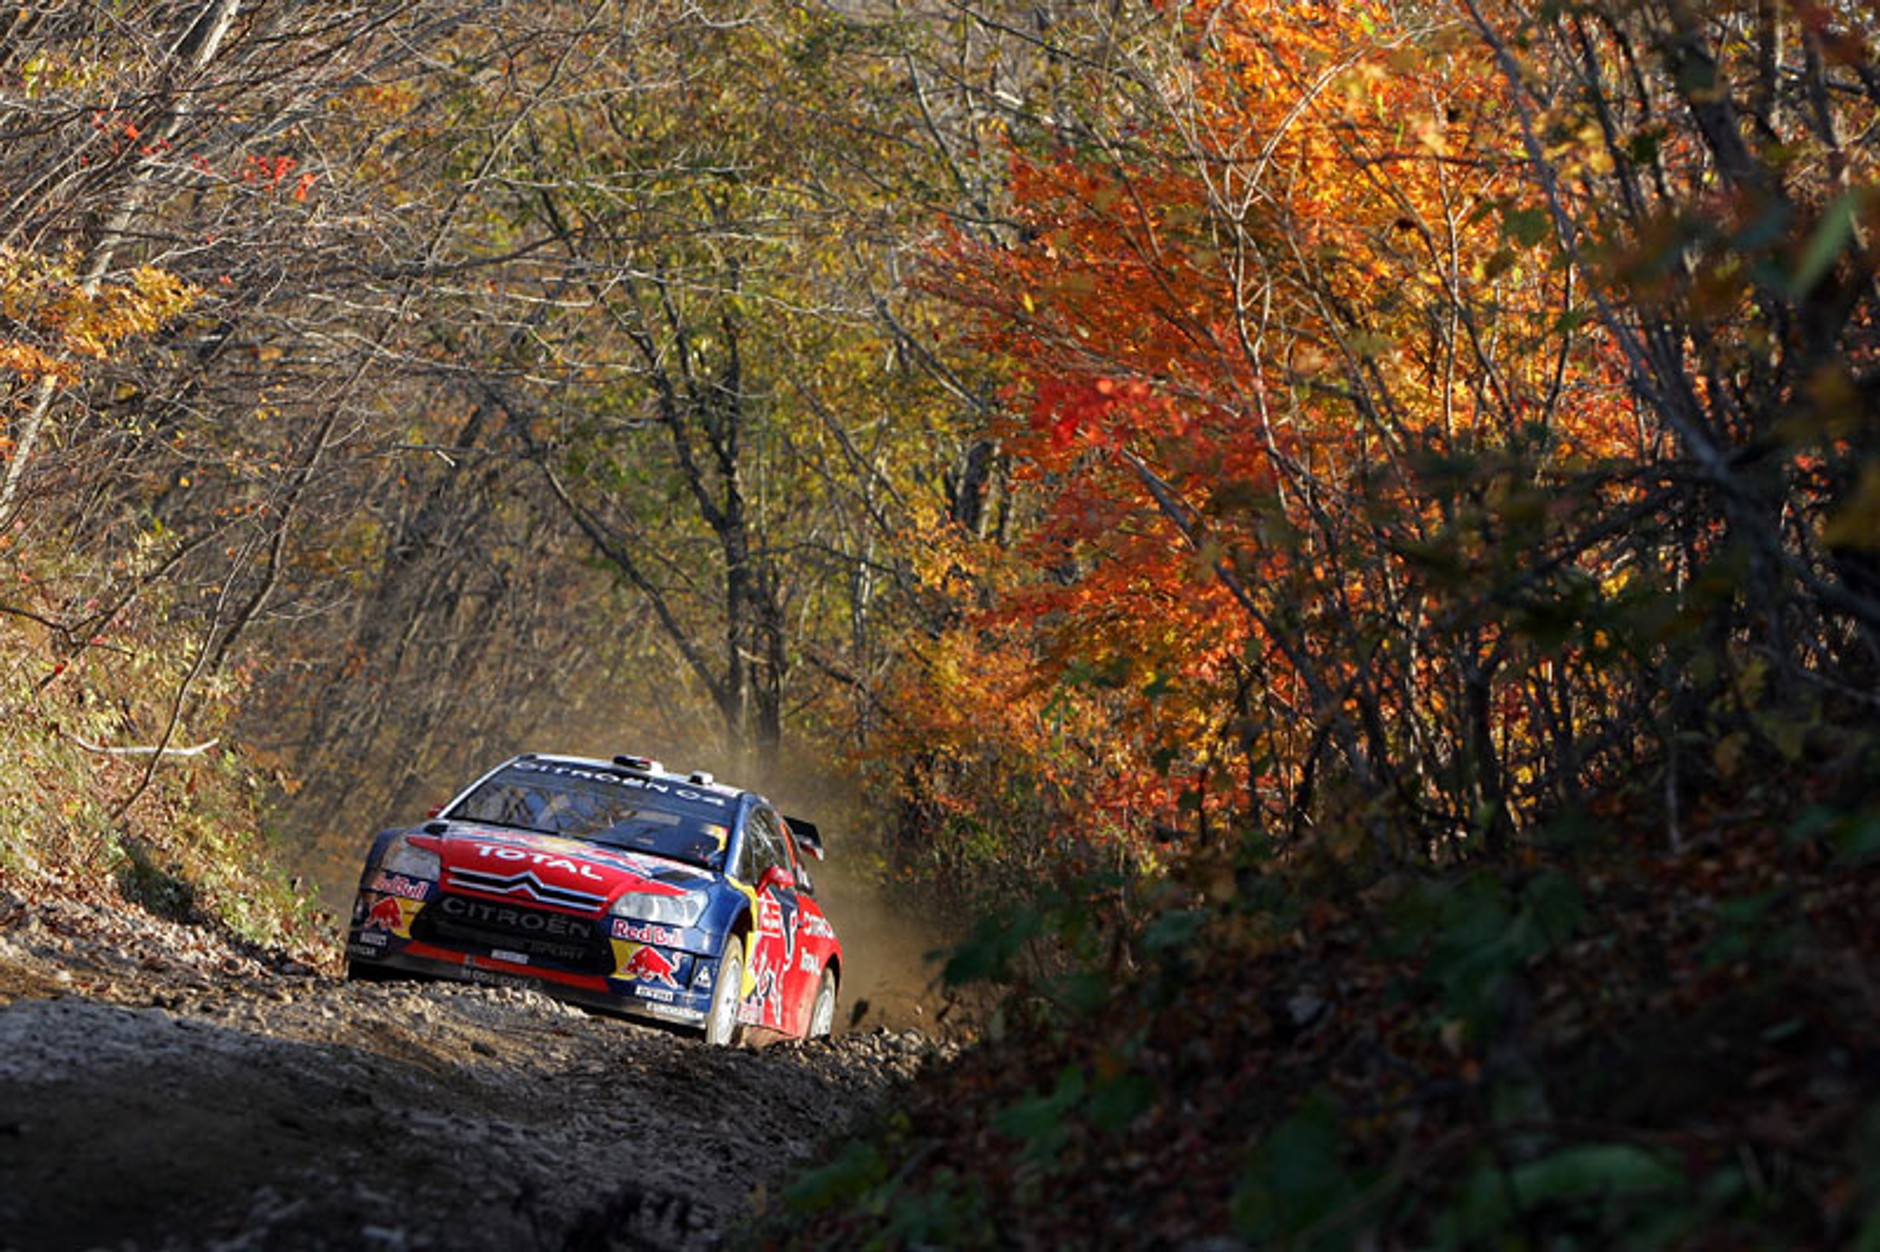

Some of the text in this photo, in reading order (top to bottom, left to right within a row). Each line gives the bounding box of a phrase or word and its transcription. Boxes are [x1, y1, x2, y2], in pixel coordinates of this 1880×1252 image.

[475, 843, 603, 881] TOTAL
[441, 896, 594, 939] CITROËN
[612, 918, 652, 942] Red
